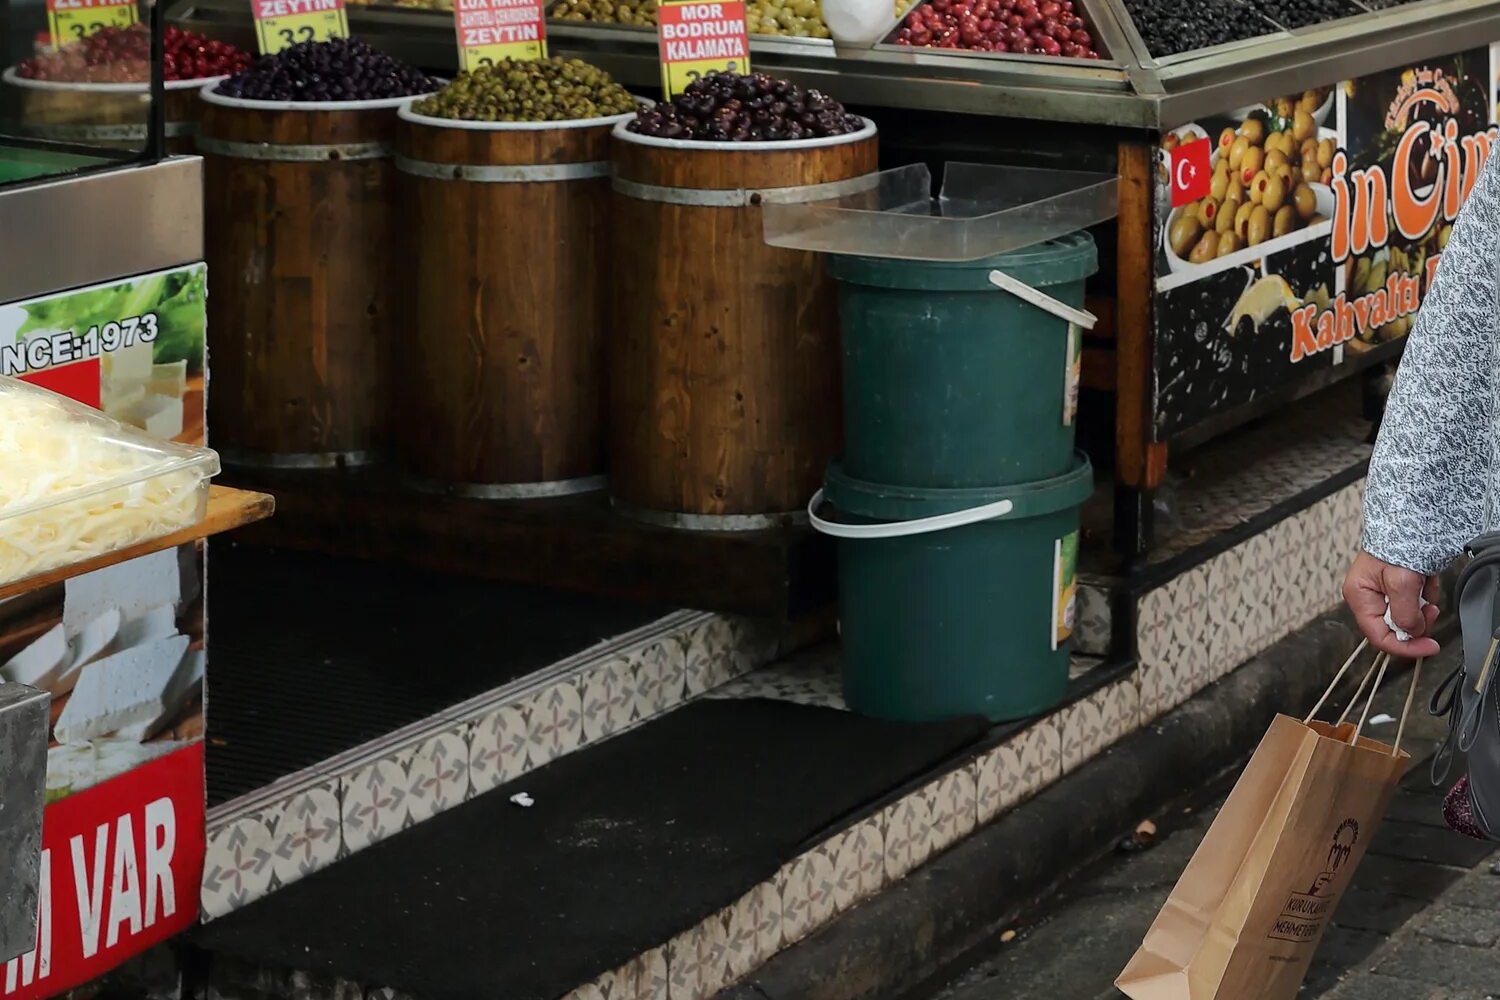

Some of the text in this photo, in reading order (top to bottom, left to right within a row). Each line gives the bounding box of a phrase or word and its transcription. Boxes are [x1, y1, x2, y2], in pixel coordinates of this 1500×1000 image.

[681, 4, 724, 20] MOR
[463, 24, 539, 44] ZEYTiN
[662, 19, 744, 39] BODRUM
[667, 38, 744, 60] KALAMATA
[1290, 271, 1420, 363] Kahvaltı
[70, 797, 177, 959] VAR
